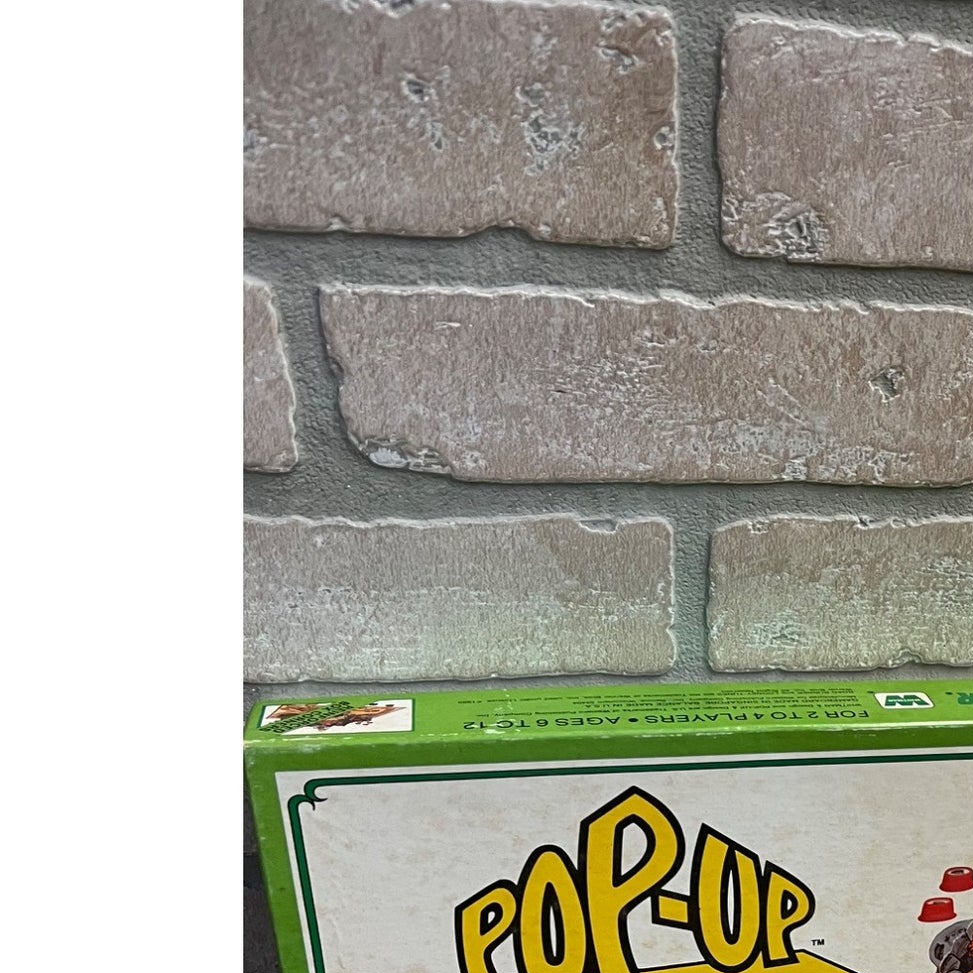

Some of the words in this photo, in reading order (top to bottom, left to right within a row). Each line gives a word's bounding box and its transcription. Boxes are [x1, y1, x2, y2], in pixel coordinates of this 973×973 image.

[754, 712, 765, 720] 4
[770, 711, 802, 720] TO
[808, 711, 819, 719] 2
[825, 710, 869, 718] FOR
[555, 716, 621, 726] AGES
[645, 712, 747, 725] PLAYERS
[536, 719, 548, 727] 6
